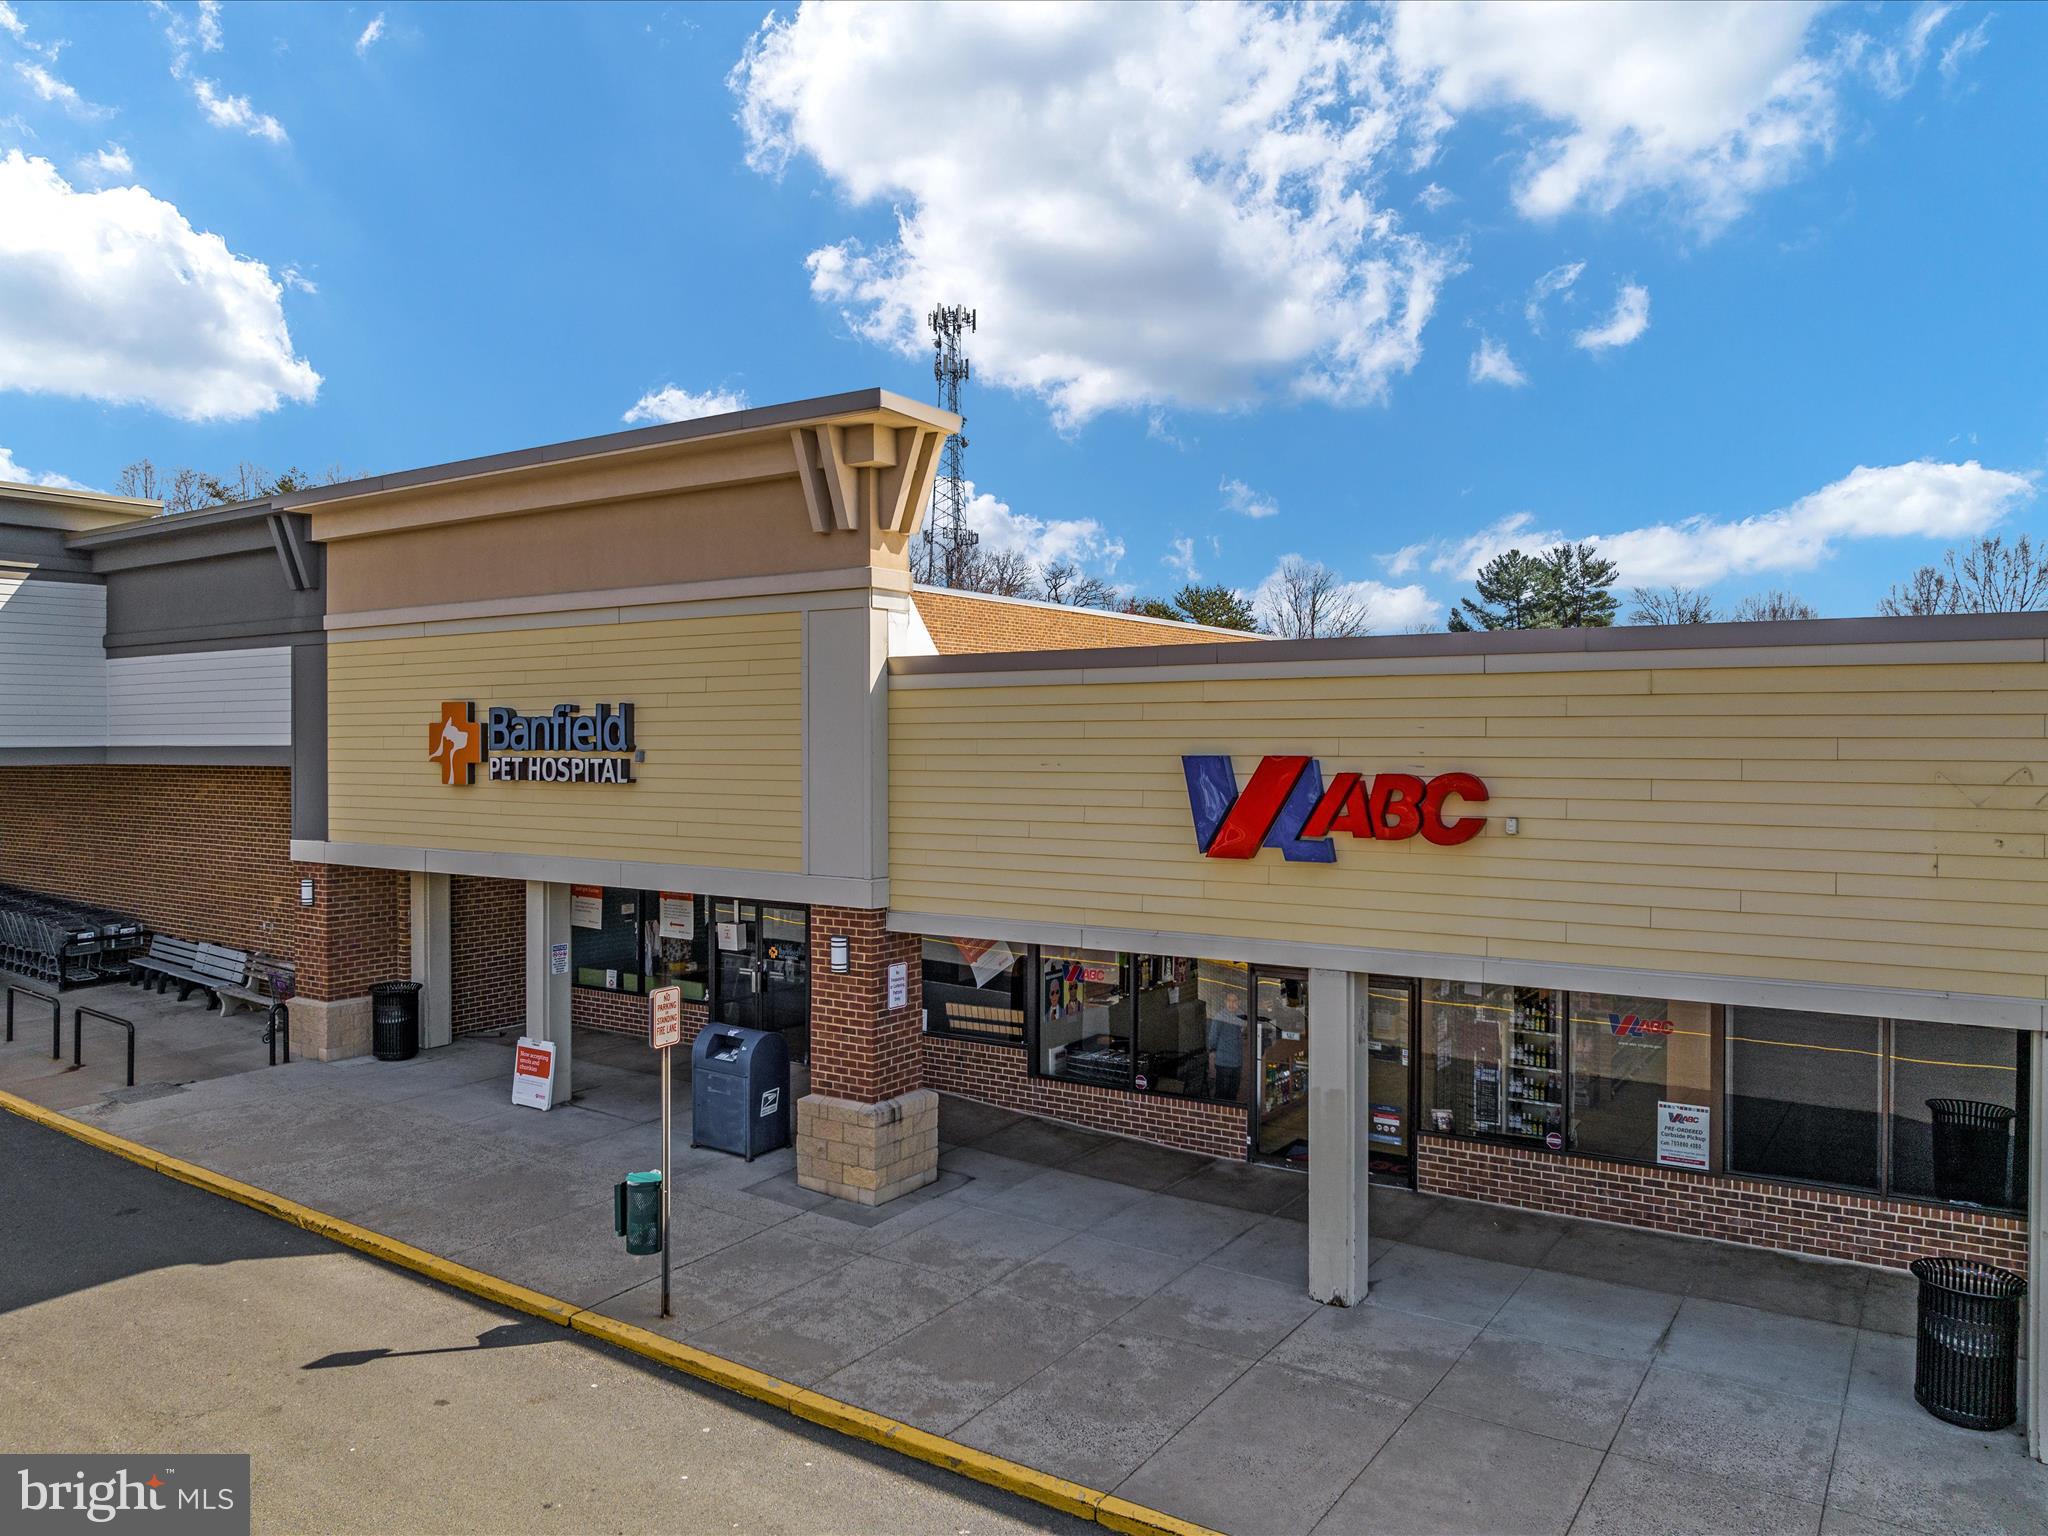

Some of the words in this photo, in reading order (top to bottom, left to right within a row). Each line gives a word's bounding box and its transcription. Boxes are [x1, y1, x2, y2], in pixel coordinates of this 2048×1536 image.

[489, 703, 634, 752] Banfield
[490, 757, 522, 781] PET
[528, 758, 629, 784] HOSPITAL
[1298, 772, 1489, 846] ABC
[663, 992, 671, 1002] NO
[656, 1001, 677, 1012] PARKING
[656, 1013, 678, 1025] STANDING
[656, 1025, 666, 1036] FIRE
[666, 1023, 677, 1034] LANE
[1637, 1019, 1674, 1035] ABC
[1682, 1115, 1700, 1123] ABC
[1664, 1125, 1704, 1136] PRE-ORDERED
[1660, 1131, 1686, 1140] Curbside
[1686, 1134, 1706, 1143] Pickup
